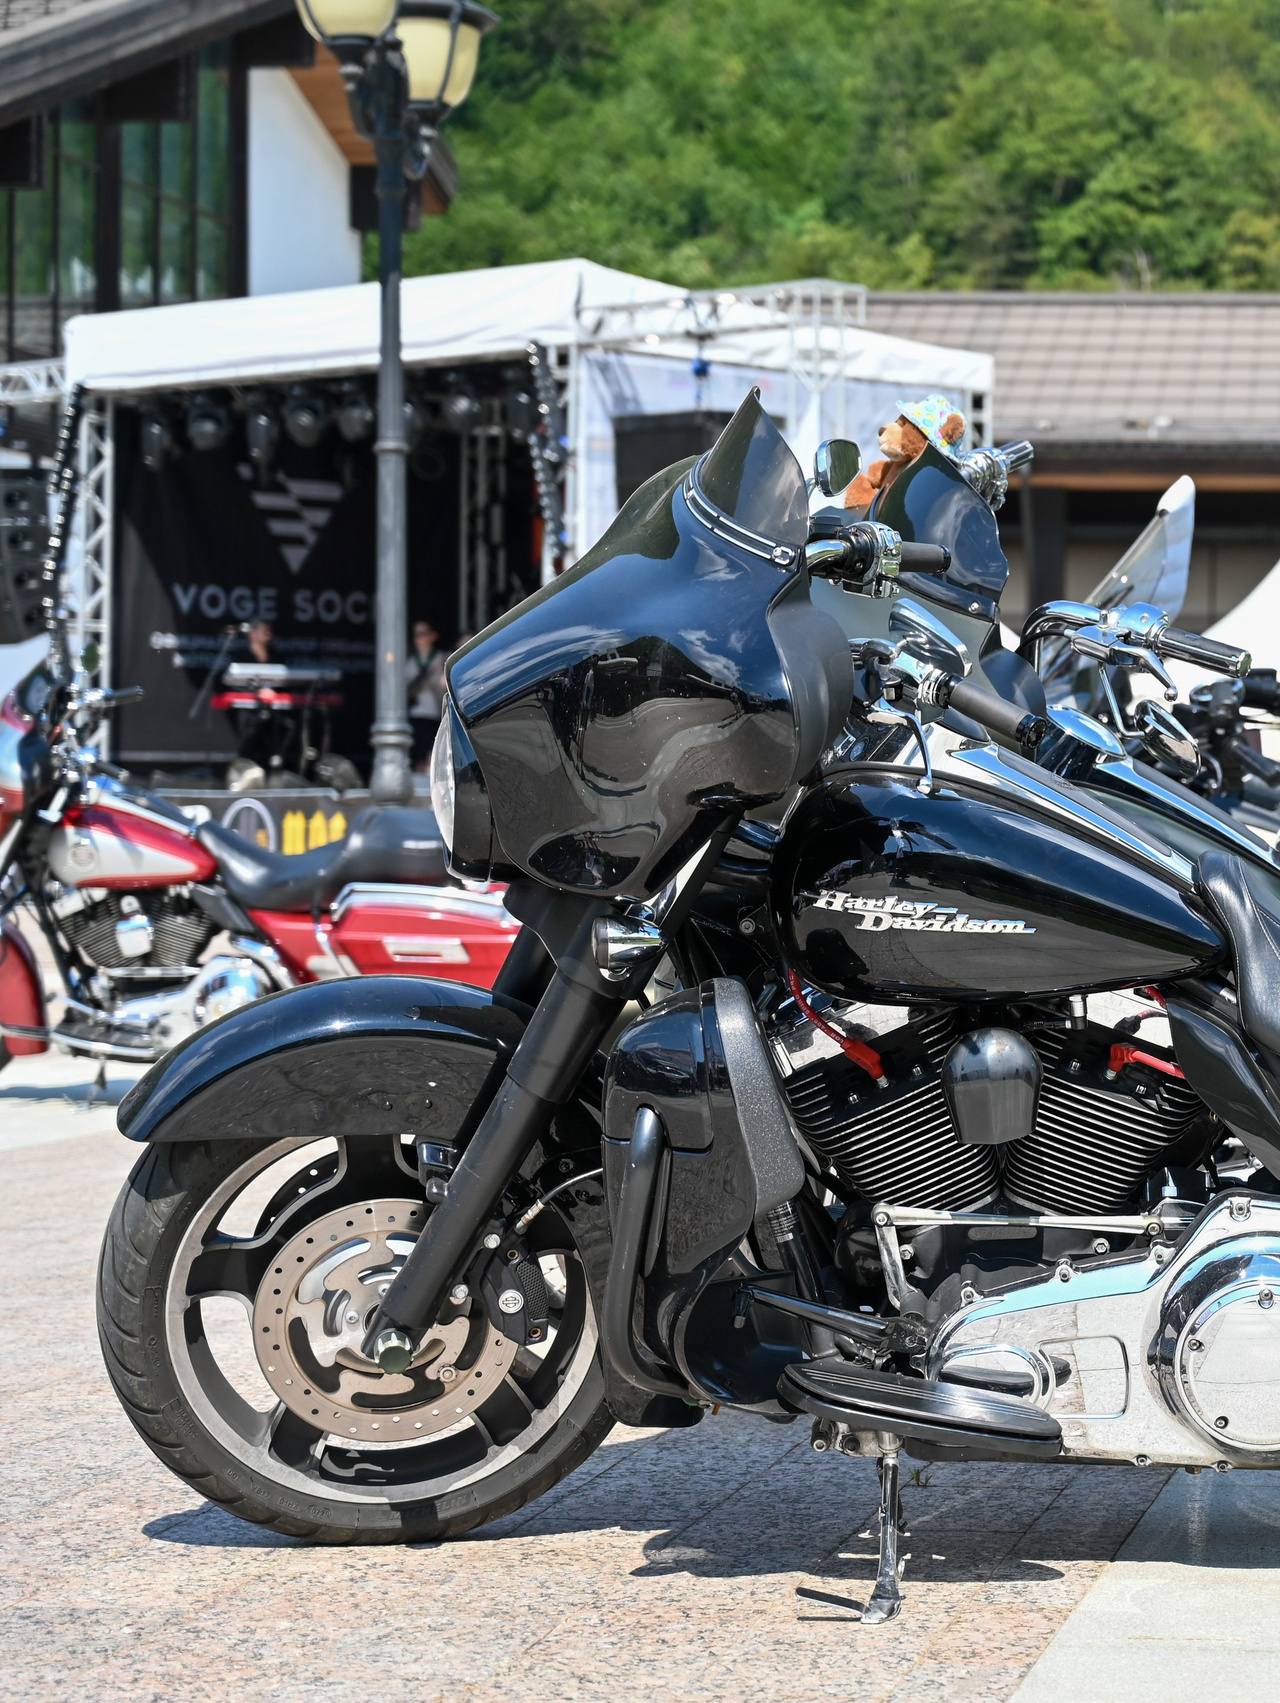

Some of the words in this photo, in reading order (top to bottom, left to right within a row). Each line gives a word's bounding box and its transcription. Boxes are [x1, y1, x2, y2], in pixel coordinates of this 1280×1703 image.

[173, 584, 279, 620] VOGE
[293, 590, 376, 624] SOC
[812, 889, 959, 920] Harley
[855, 911, 1037, 934] Davidson
